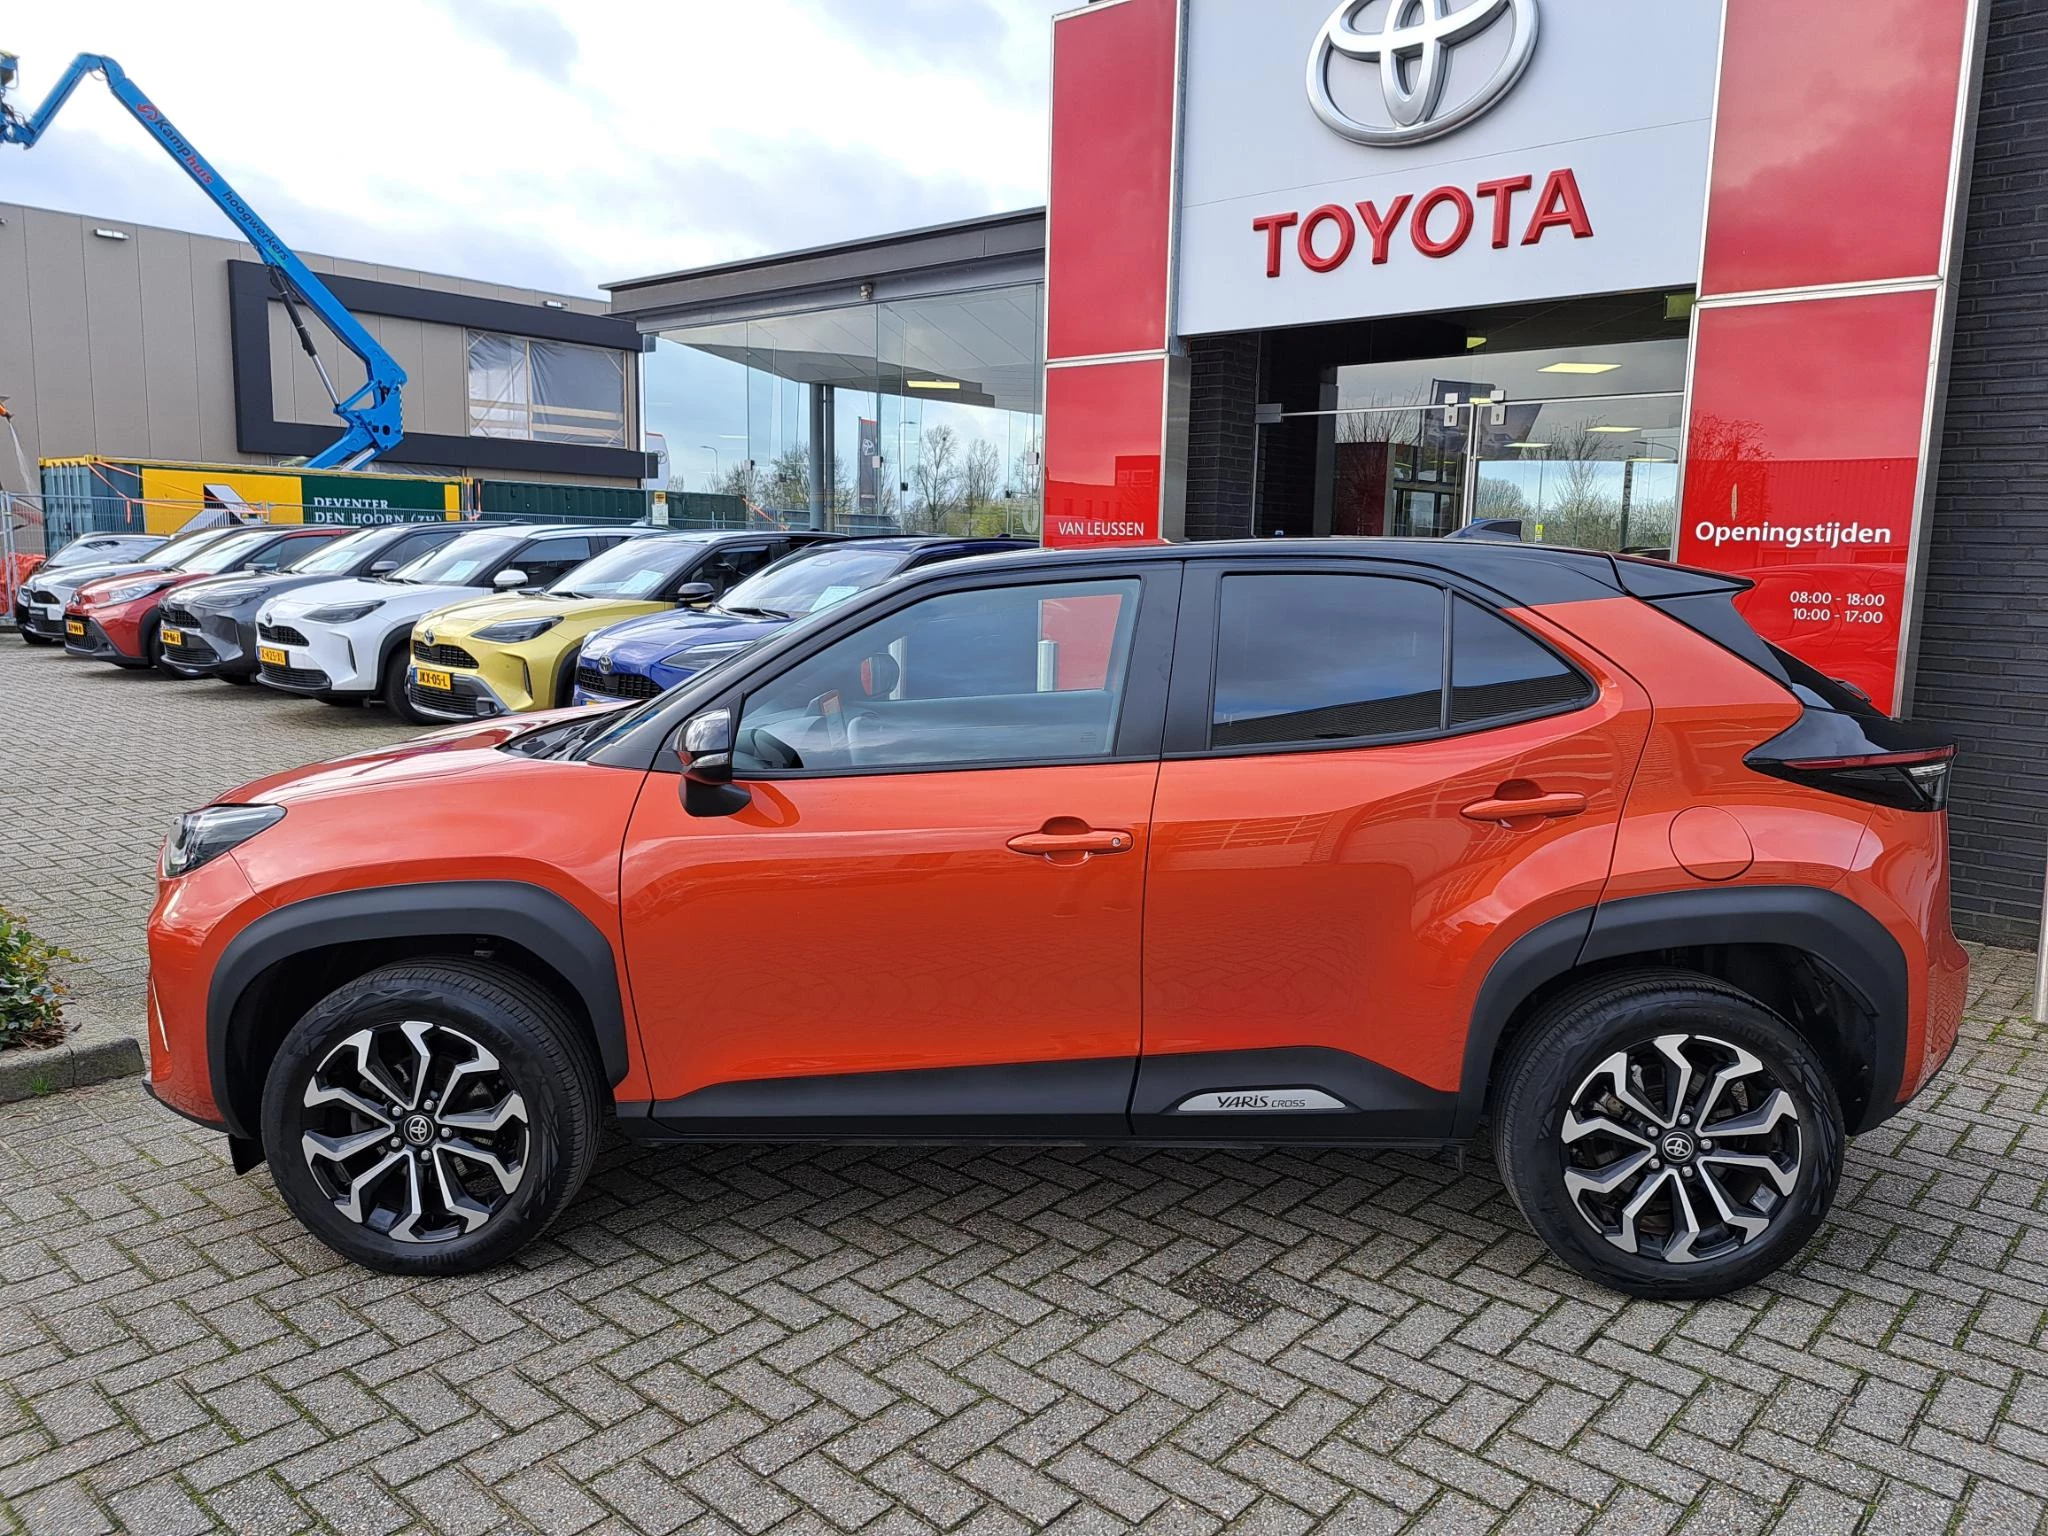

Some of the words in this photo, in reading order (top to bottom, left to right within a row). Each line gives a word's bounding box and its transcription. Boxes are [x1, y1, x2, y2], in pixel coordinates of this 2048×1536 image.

[155, 119, 213, 183] Kamphuis
[222, 190, 289, 260] hoogwerkers
[1253, 168, 1594, 278] TOYOTA
[313, 496, 389, 509] DEVENTER
[314, 511, 345, 523] DEN
[351, 513, 404, 525] HOORN
[1058, 521, 1084, 536] VAN
[1087, 521, 1144, 537] LEUSSEN
[1695, 521, 1891, 548] Openingstijden
[1789, 591, 1832, 605] 08:00
[1846, 592, 1885, 607] 18:00
[1792, 607, 1831, 621] 10:00
[1845, 610, 1883, 624] 17:00
[418, 670, 449, 688] JKX-05-L
[1271, 1099, 1306, 1108] CROSS
